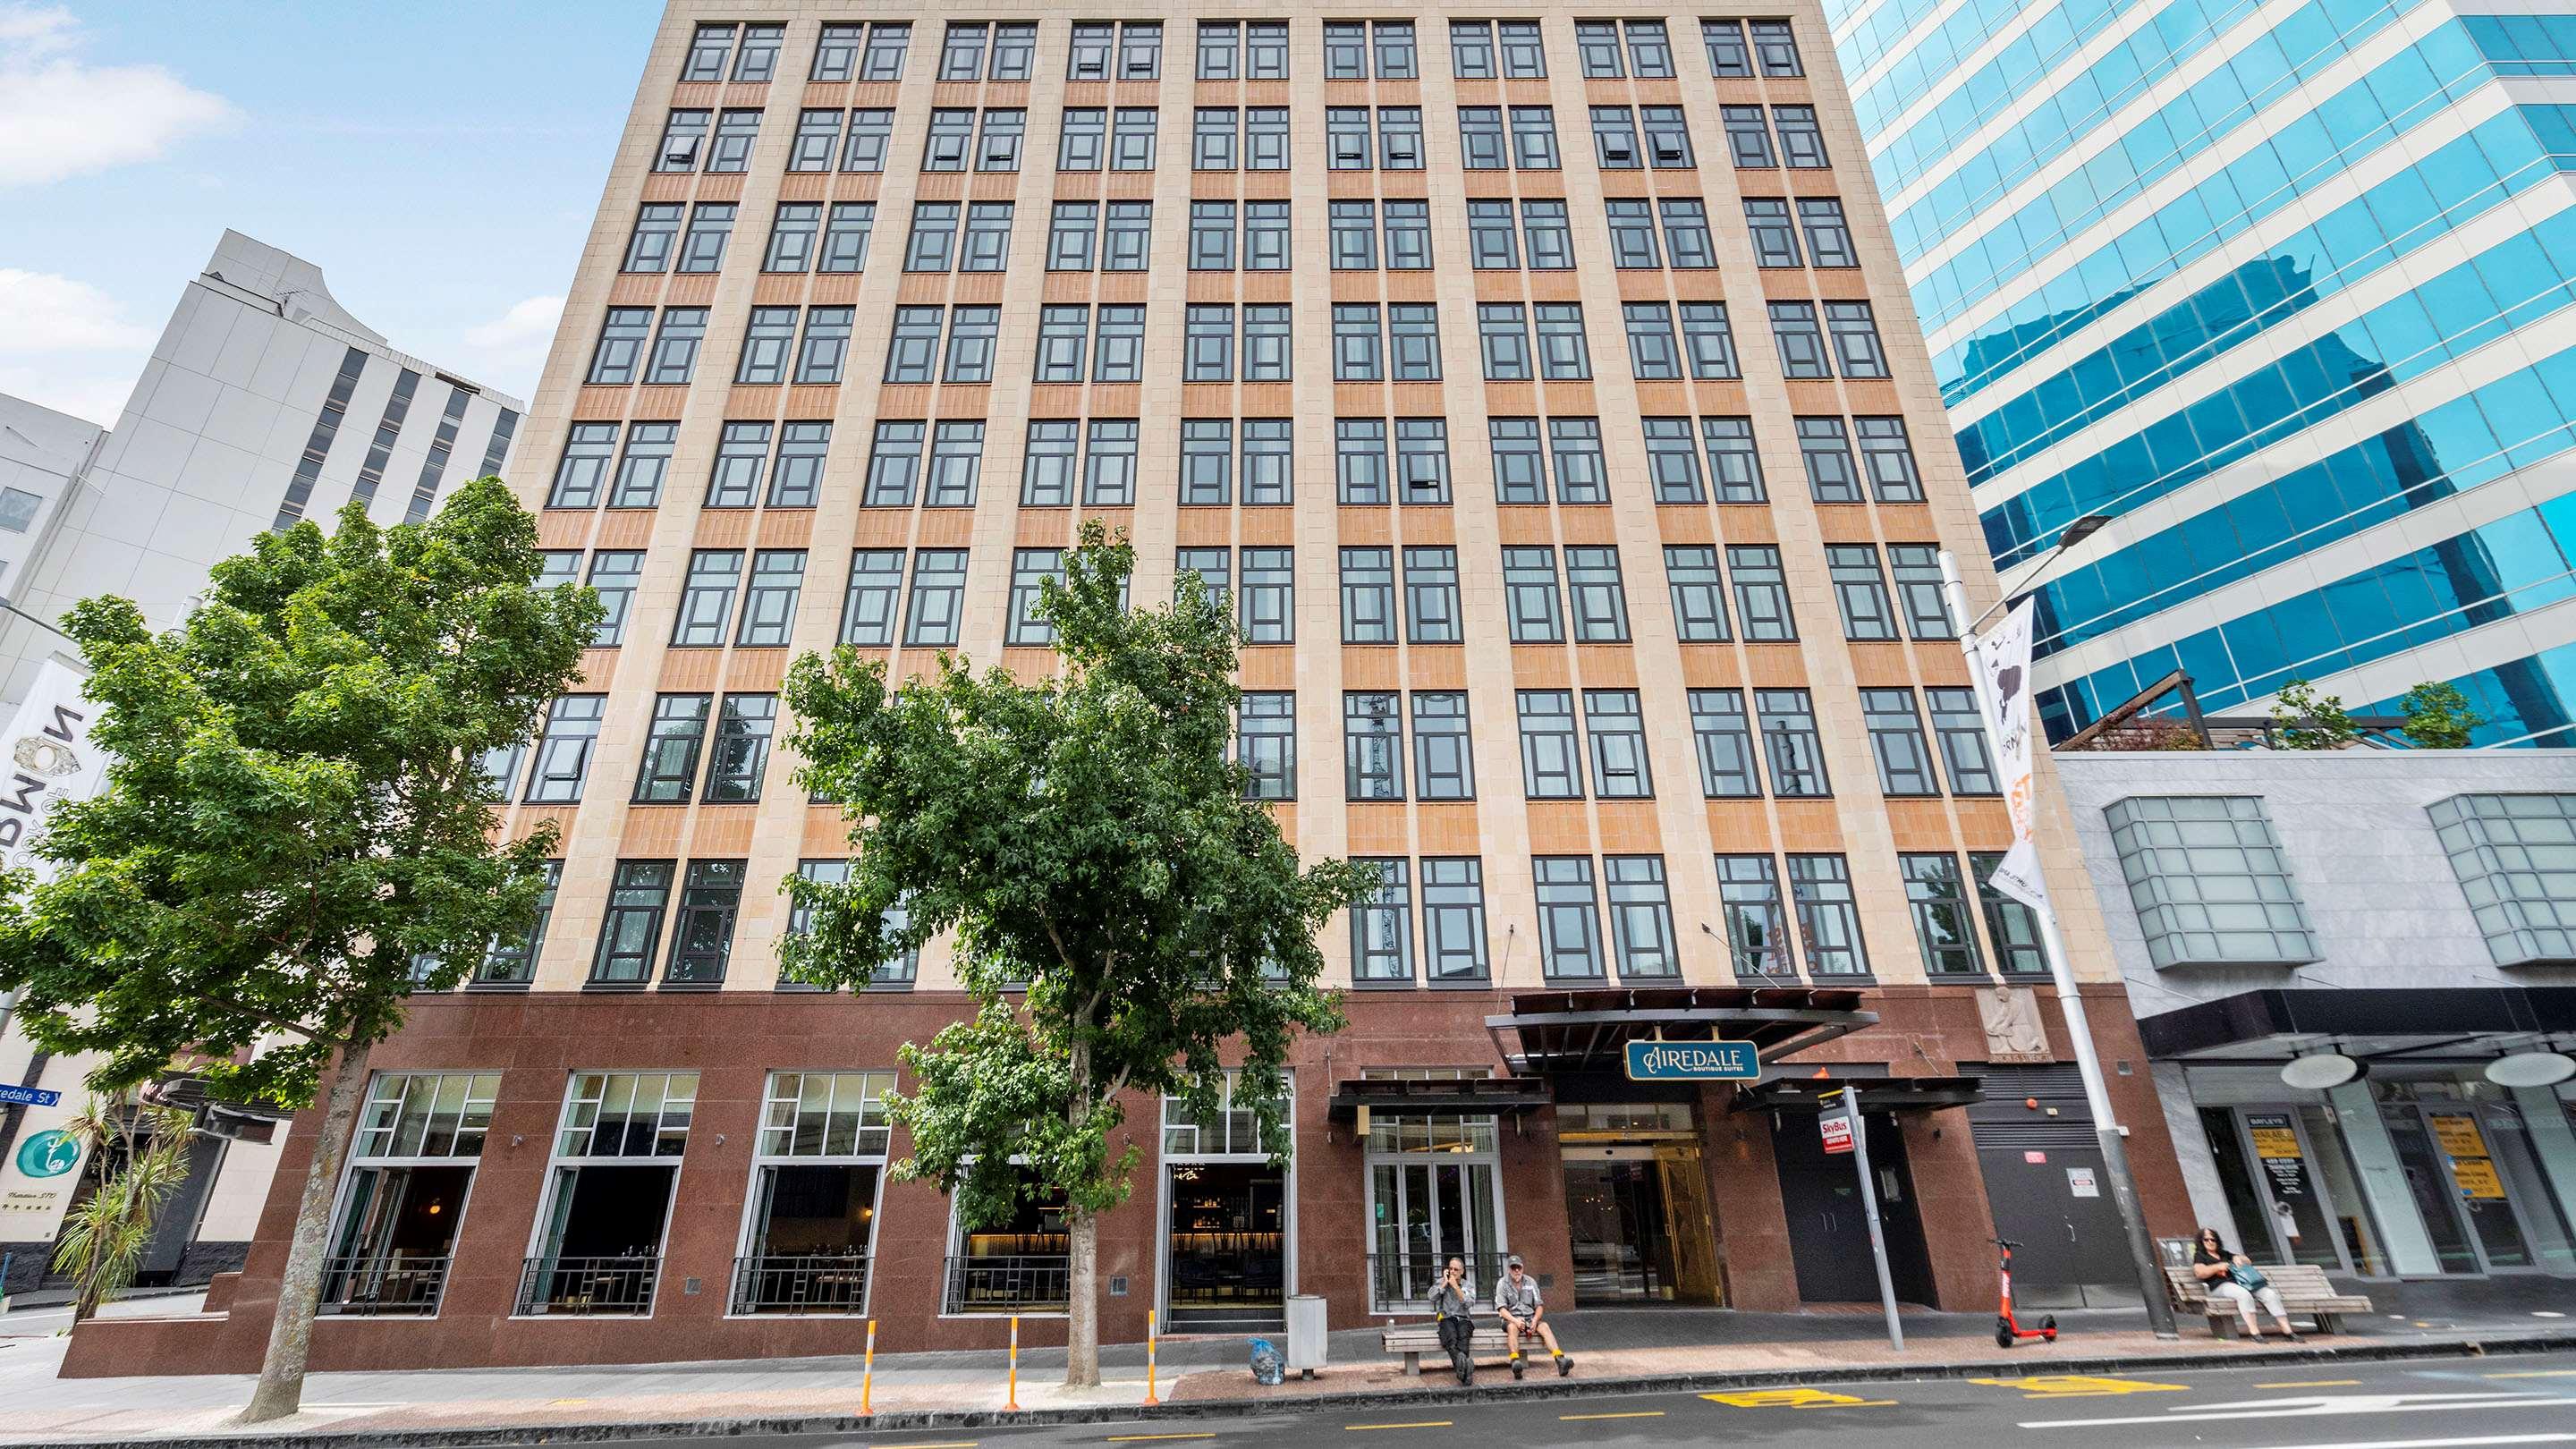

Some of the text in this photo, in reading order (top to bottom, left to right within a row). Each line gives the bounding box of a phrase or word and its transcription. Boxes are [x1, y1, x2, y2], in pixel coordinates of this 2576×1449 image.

[1643, 1046, 1743, 1073] AIREDALE
[0, 1089, 51, 1104] edale St
[1822, 1122, 1847, 1135] SkyBus
